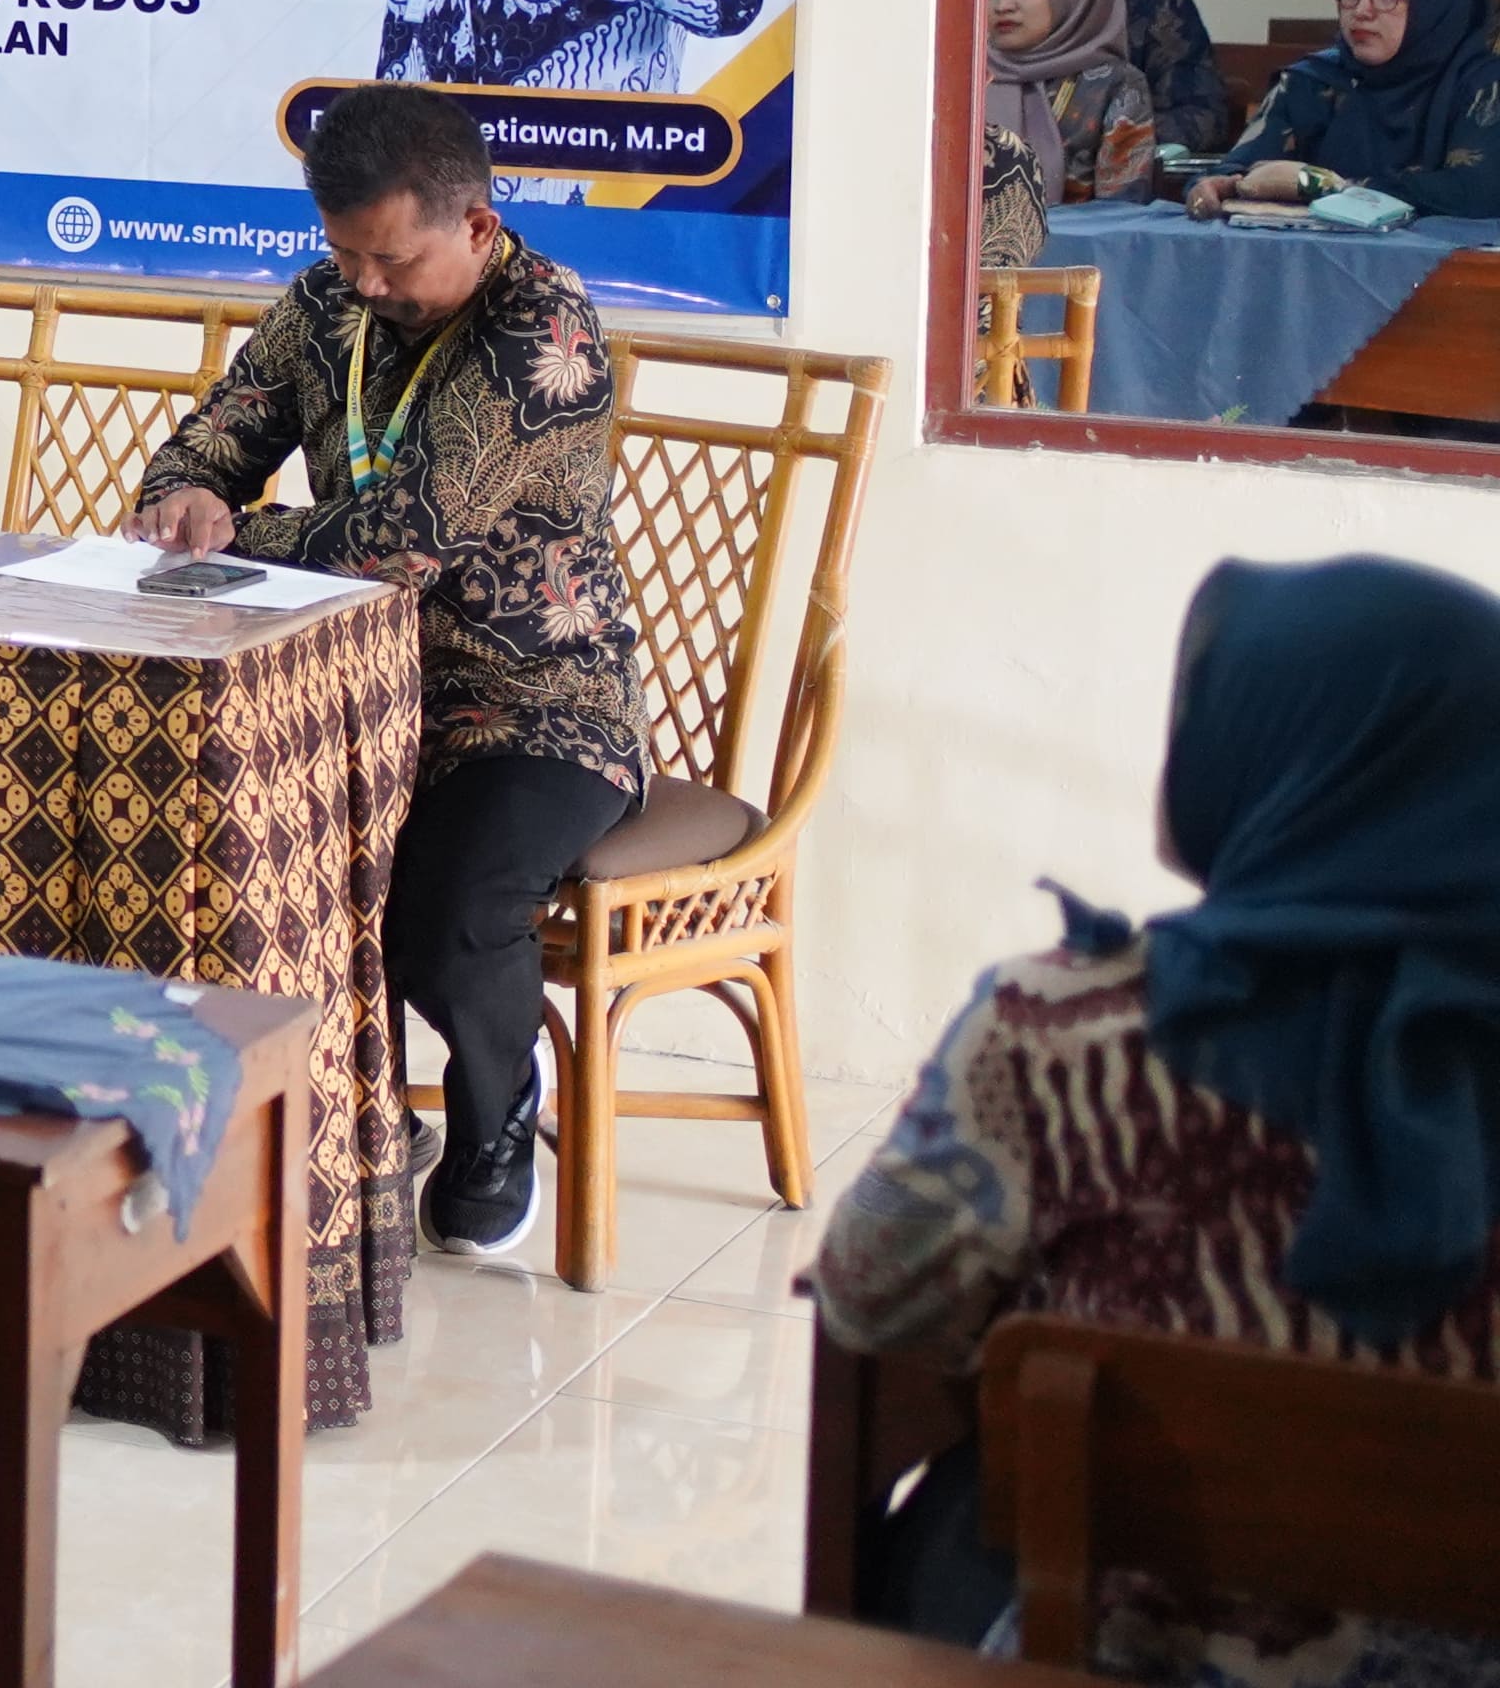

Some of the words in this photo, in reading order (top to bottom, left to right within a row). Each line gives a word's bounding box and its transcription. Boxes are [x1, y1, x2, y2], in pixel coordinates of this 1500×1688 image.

[479, 120, 617, 152] etiawan,
[626, 125, 706, 154] M.Pd
[108, 219, 332, 258] www.smkpgri2
